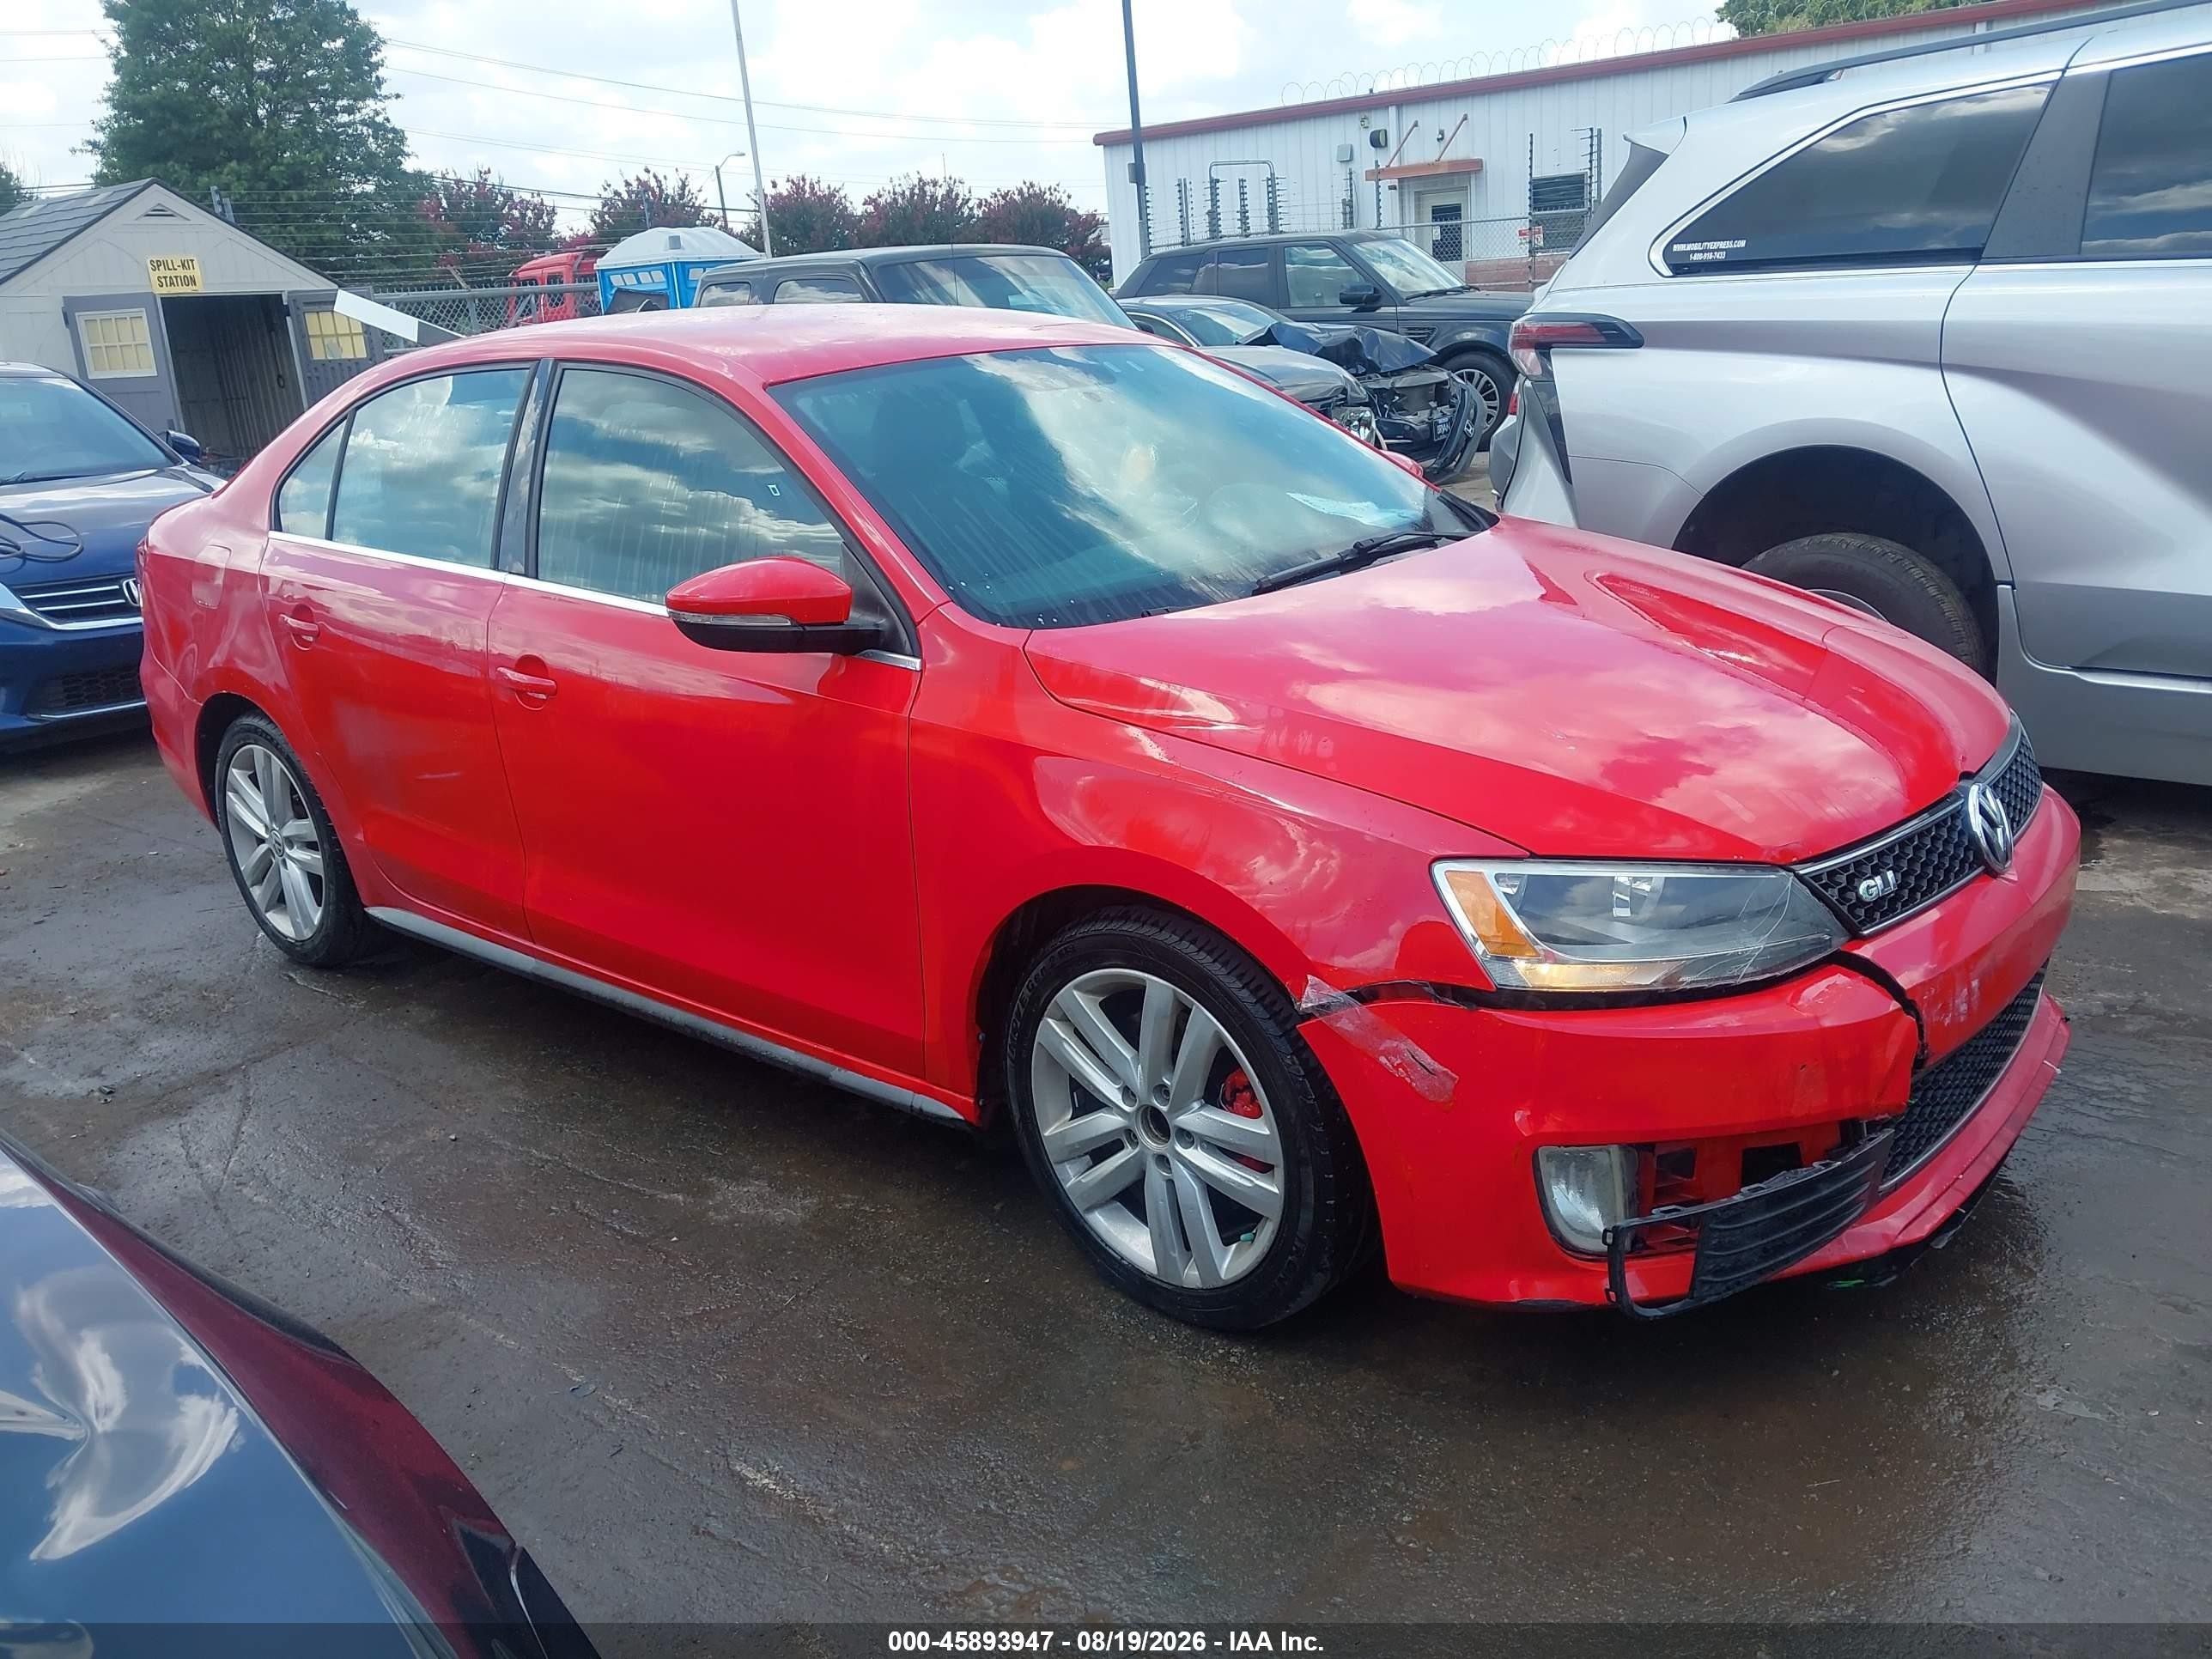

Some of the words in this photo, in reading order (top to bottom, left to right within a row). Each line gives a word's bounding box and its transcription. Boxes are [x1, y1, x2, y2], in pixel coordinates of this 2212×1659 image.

[149, 258, 195, 271] SPILL-KIT
[157, 275, 197, 288] STATION
[1859, 870, 1899, 902] GLI
